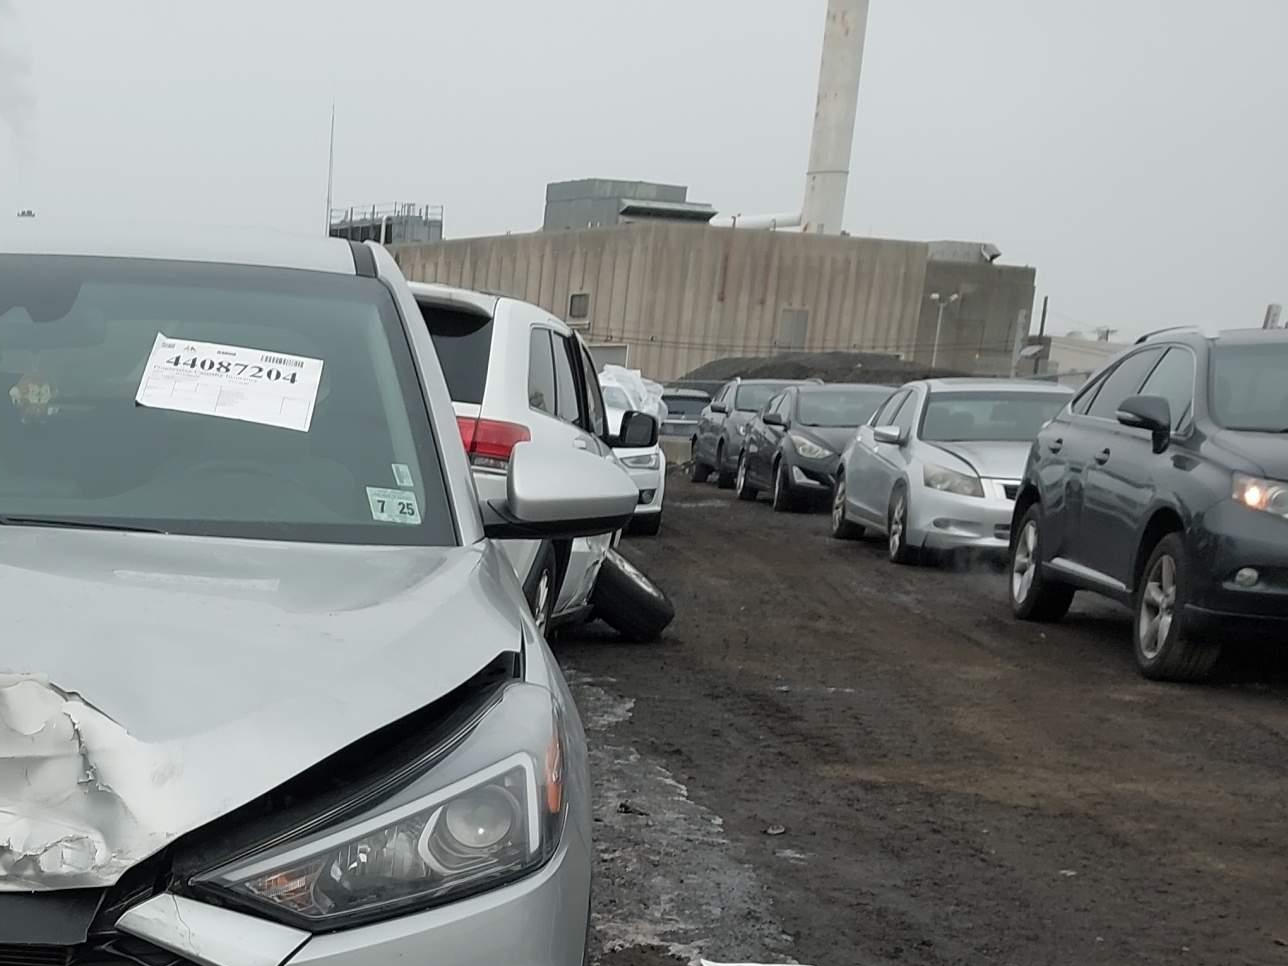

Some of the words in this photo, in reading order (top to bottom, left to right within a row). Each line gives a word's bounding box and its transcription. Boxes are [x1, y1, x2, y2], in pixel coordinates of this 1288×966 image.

[165, 354, 299, 384] 44087204
[376, 499, 386, 514] 7
[397, 501, 415, 517] 25
